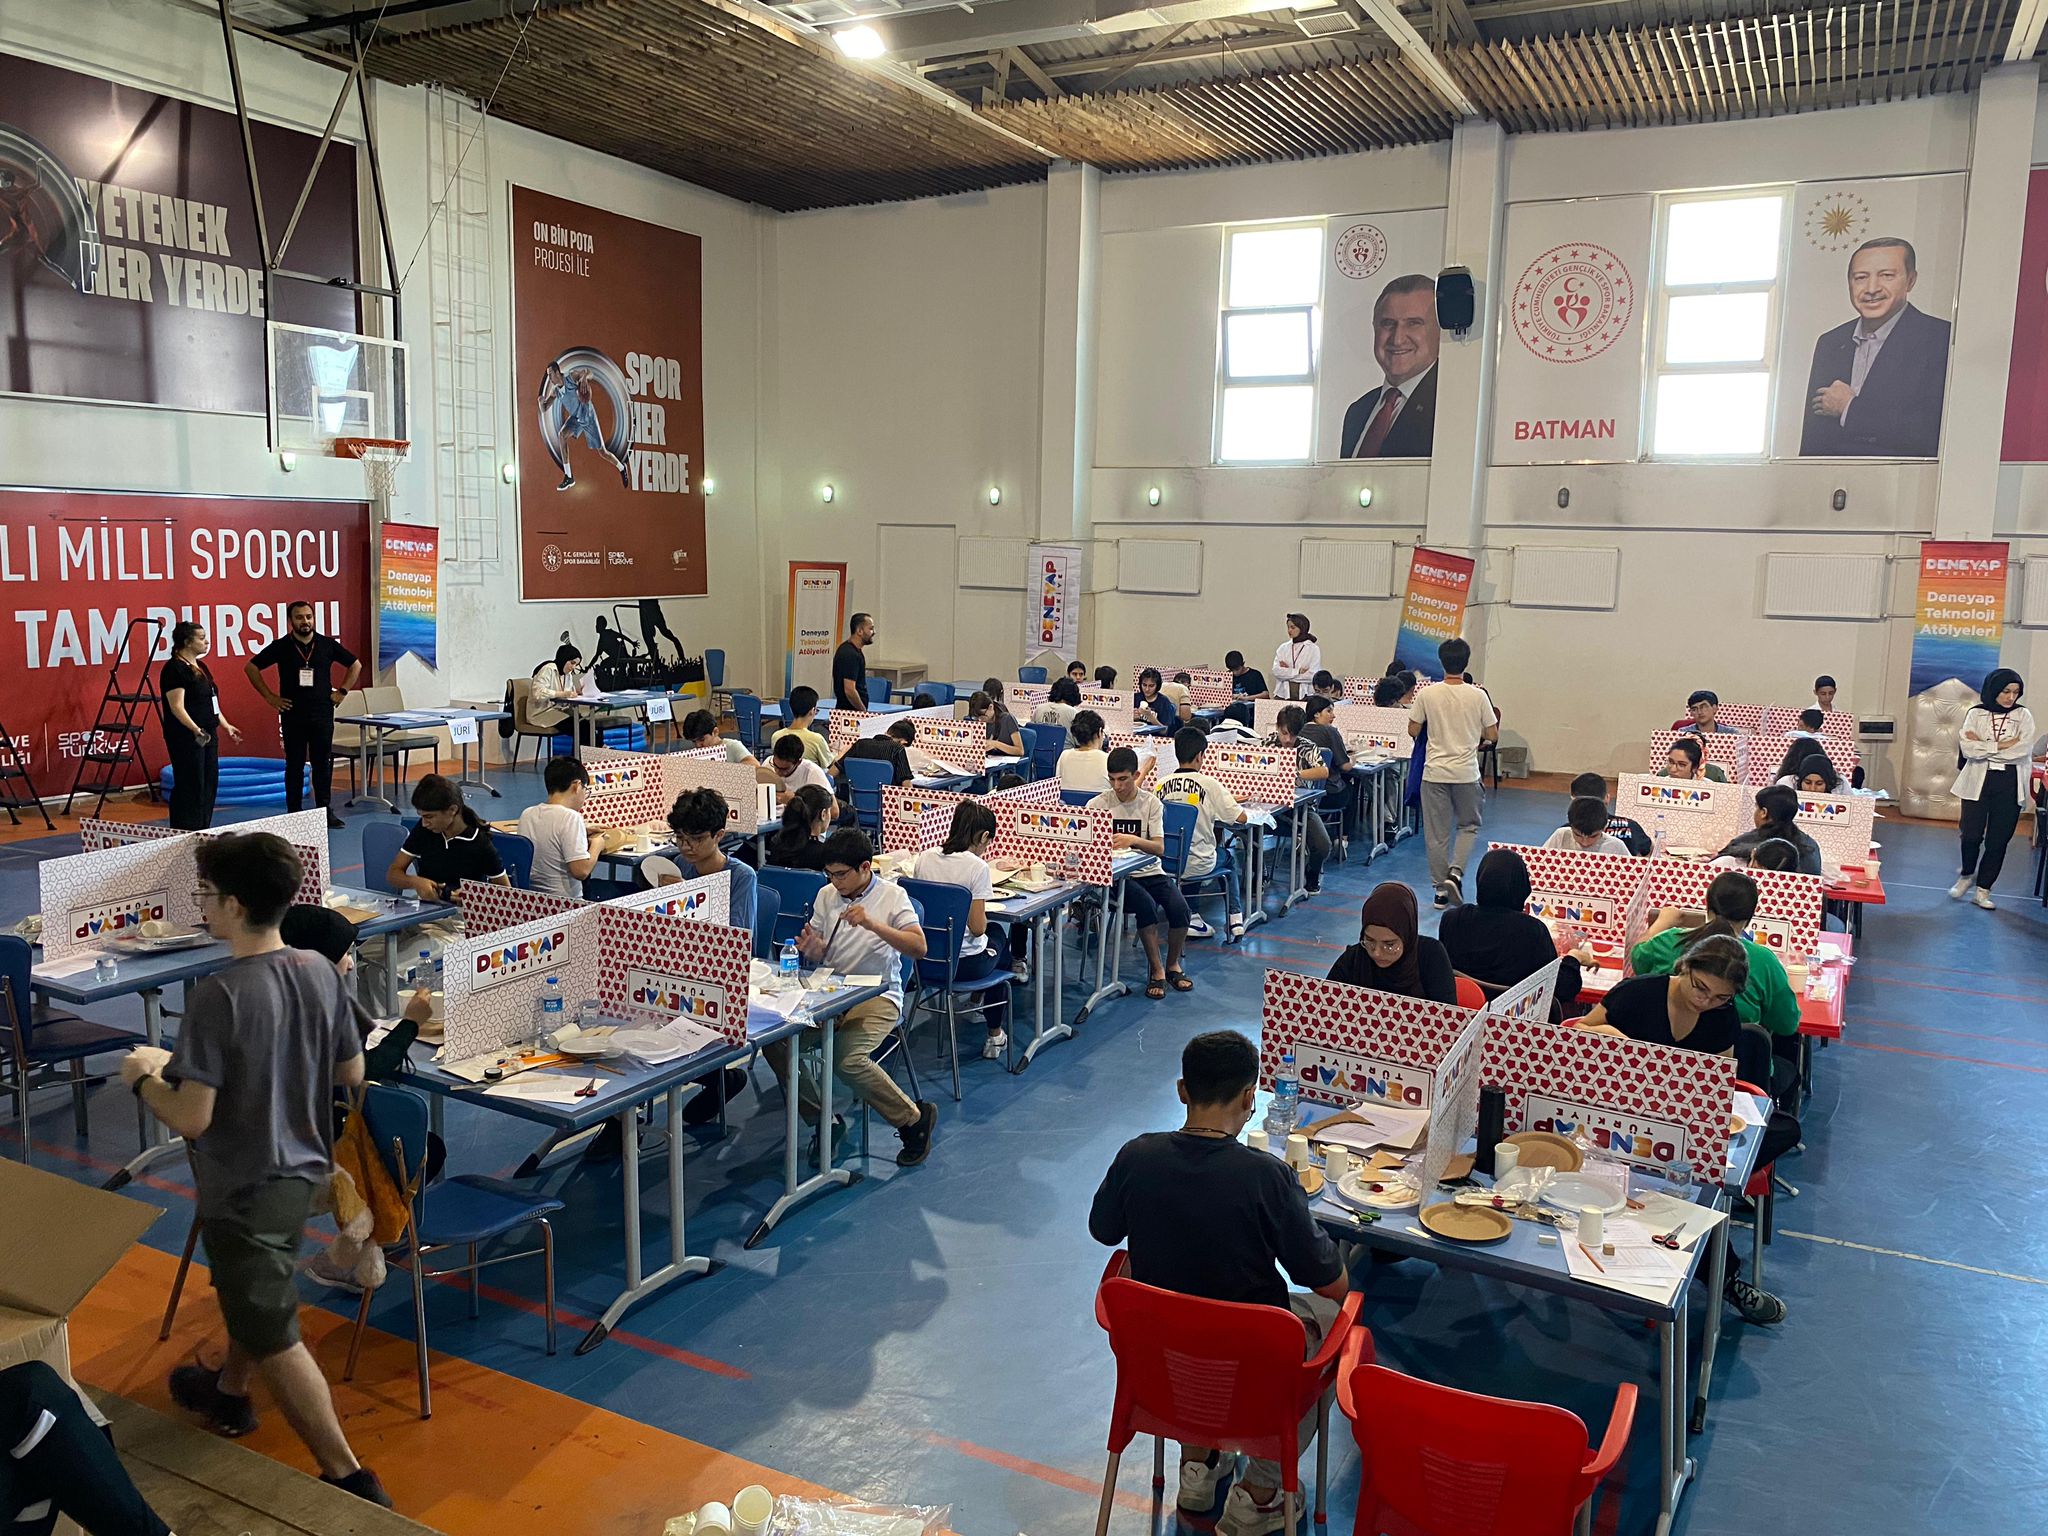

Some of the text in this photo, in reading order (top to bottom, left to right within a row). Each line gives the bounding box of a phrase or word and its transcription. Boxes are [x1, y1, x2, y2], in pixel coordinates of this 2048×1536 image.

[74, 177, 231, 257] YETENEK
[533, 221, 594, 254] ON BİN POTA
[534, 247, 590, 277] PROJESİ İLE
[1563, 265, 1596, 276] GENÇLİK
[79, 239, 265, 318] HER YERDE
[1595, 273, 1605, 282] VE
[1534, 269, 1561, 317] CUMHURİYETİ
[1601, 282, 1612, 302] SPOR
[1535, 317, 1560, 340] TÜRKİYE
[625, 351, 682, 401] SPOR
[627, 400, 666, 446] HER
[1514, 419, 1616, 440] BATMAN
[627, 449, 690, 494] YERDE
[58, 516, 175, 582] MİLLİ
[190, 528, 340, 580] SPORCU
[385, 539, 434, 552] DENEYAP
[1414, 563, 1467, 583] DENEYAP
[1926, 559, 2001, 571] DENEYAP
[388, 570, 432, 583] Deneyap
[386, 585, 432, 598] Teknoloji
[1927, 591, 1995, 605] Deneyap
[384, 601, 434, 613] Atölyeleri
[1042, 561, 1057, 642] DENEYAP
[1410, 592, 1458, 612] Deneyap
[1407, 606, 1457, 625] Teknoloji
[1924, 607, 1995, 622] Teknoloji
[15, 600, 341, 669] TAM BURS!
[1402, 620, 1455, 639] Atölyeleri
[1920, 624, 1996, 637] Atölyeleri
[1082, 694, 1120, 703] DENEYAP
[651, 703, 667, 714] JÜRİ
[453, 724, 471, 737] JÜRİ
[924, 727, 970, 738] DENEYAP
[9, 735, 30, 748] VE
[1221, 753, 1276, 765] DENEYAP
[589, 770, 638, 785] ENEYAP
[1183, 778, 1206, 804] CREW
[1641, 786, 1711, 801] DENEYAP
[1798, 802, 1847, 814] NEYAP
[1799, 812, 1834, 820] RKİYE
[1020, 813, 1088, 830] DENEYAP
[1116, 823, 1136, 834] HU
[1031, 826, 1078, 837] TÜRKİYE
[645, 892, 706, 915] NEYAP
[75, 904, 164, 938] DENEYAP
[476, 932, 565, 974] DENEYAP
[491, 955, 553, 979] TÜRKİYE
[647, 978, 705, 996] TÜRKİYE
[633, 987, 718, 1019] DENEYAP
[1319, 1055, 1403, 1081] TÜRKİYE
[1300, 1065, 1423, 1106] DENEYAP
[1556, 1107, 1654, 1135] TÜRKİYE
[1533, 1117, 1675, 1162] DENEYAP
